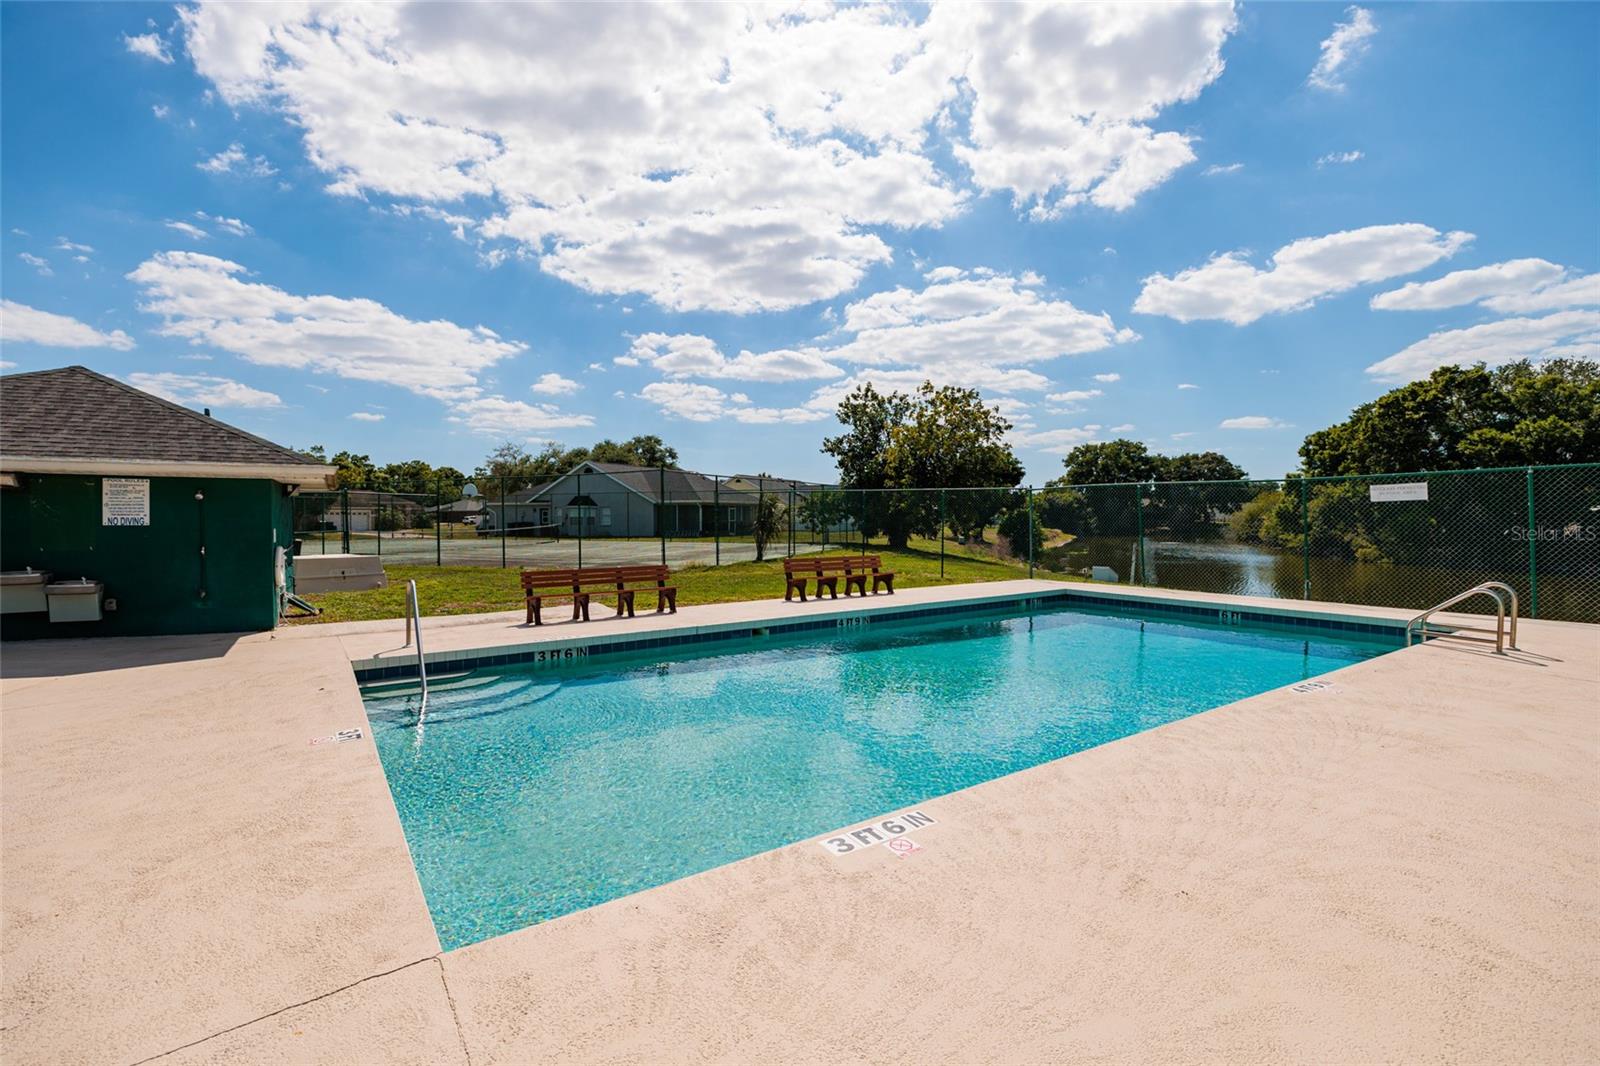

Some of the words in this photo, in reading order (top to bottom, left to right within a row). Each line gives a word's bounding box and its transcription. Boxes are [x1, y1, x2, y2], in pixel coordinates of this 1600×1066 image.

[107, 517, 119, 526] NO
[120, 517, 145, 526] DIVING
[537, 650, 546, 662] 3
[550, 650, 561, 660] FT
[564, 648, 573, 658] 6
[576, 646, 588, 657] IN
[827, 837, 855, 853] 3
[850, 827, 884, 845] FT
[881, 820, 906, 835] 6
[900, 811, 935, 829] IN
